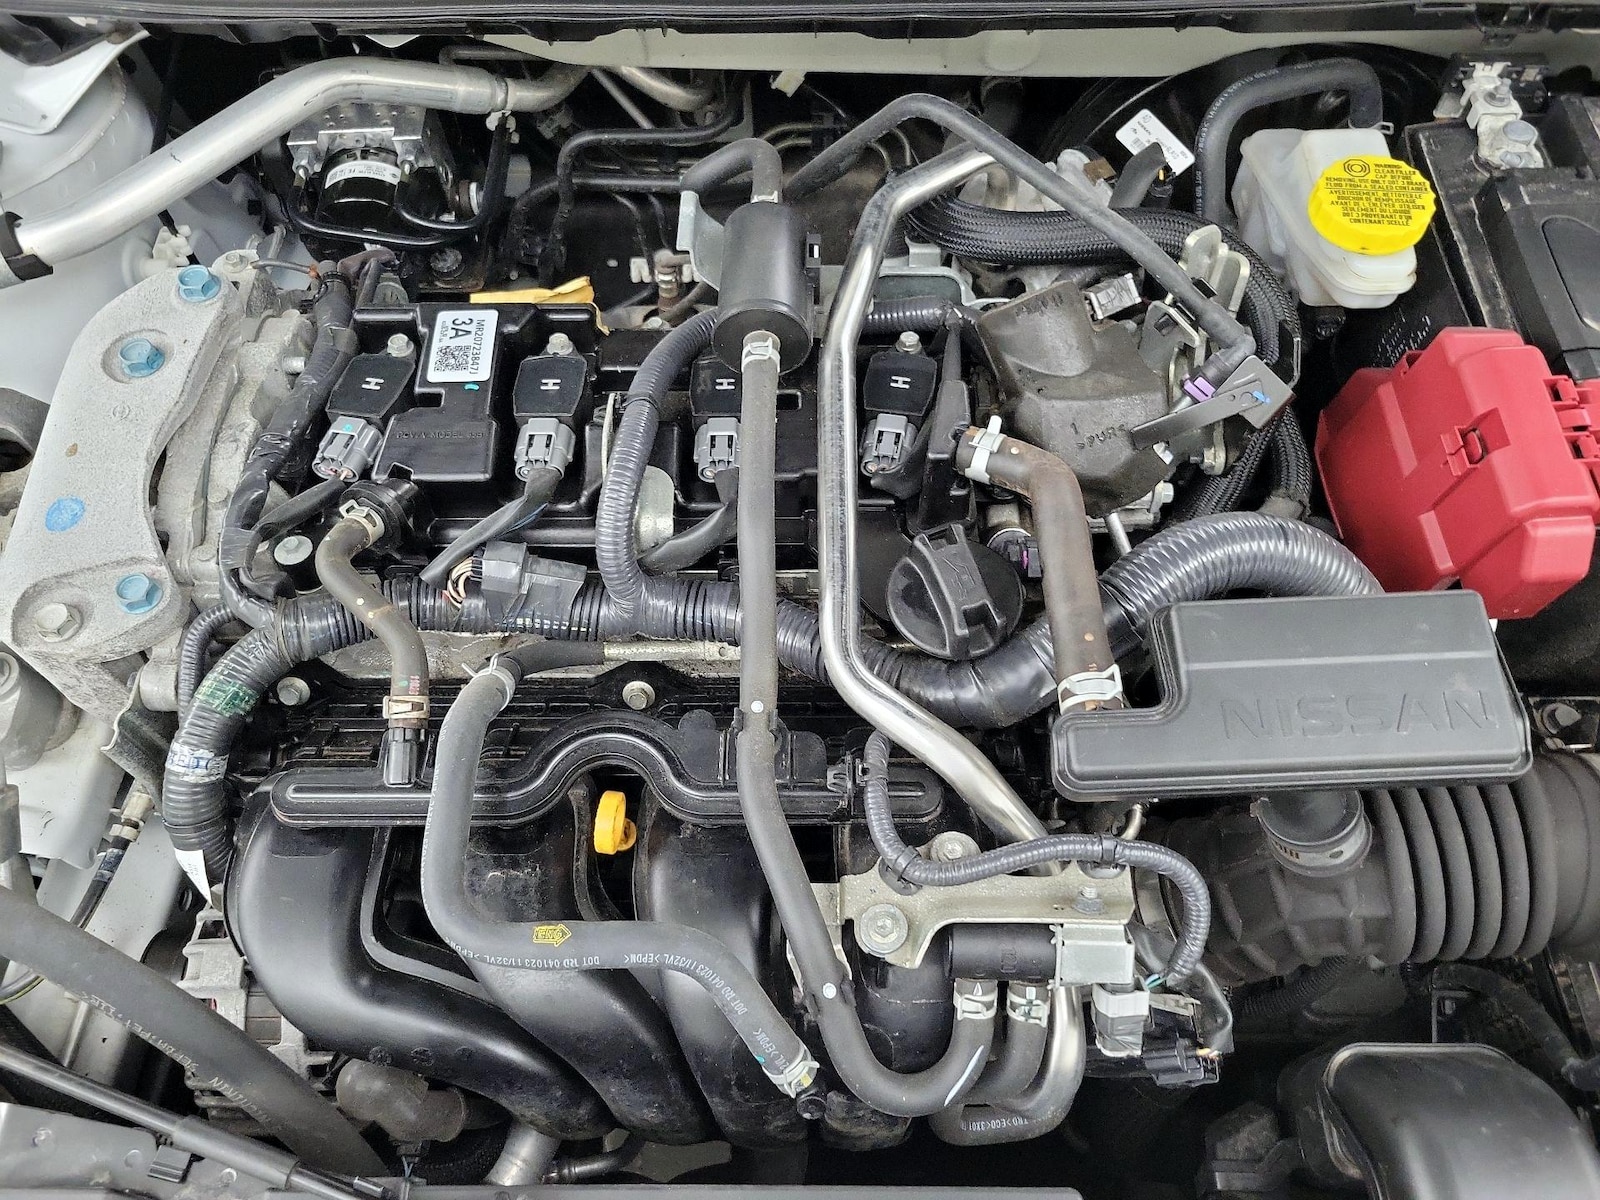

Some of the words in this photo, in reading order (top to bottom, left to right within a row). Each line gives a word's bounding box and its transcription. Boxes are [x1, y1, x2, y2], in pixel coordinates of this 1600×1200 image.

[449, 317, 473, 340] 3A
[1219, 690, 1499, 739] NISSAN
[525, 958, 560, 969] 041023
[582, 956, 600, 966] DOT
[698, 964, 725, 988] 041023
[730, 996, 748, 1016] DOT
